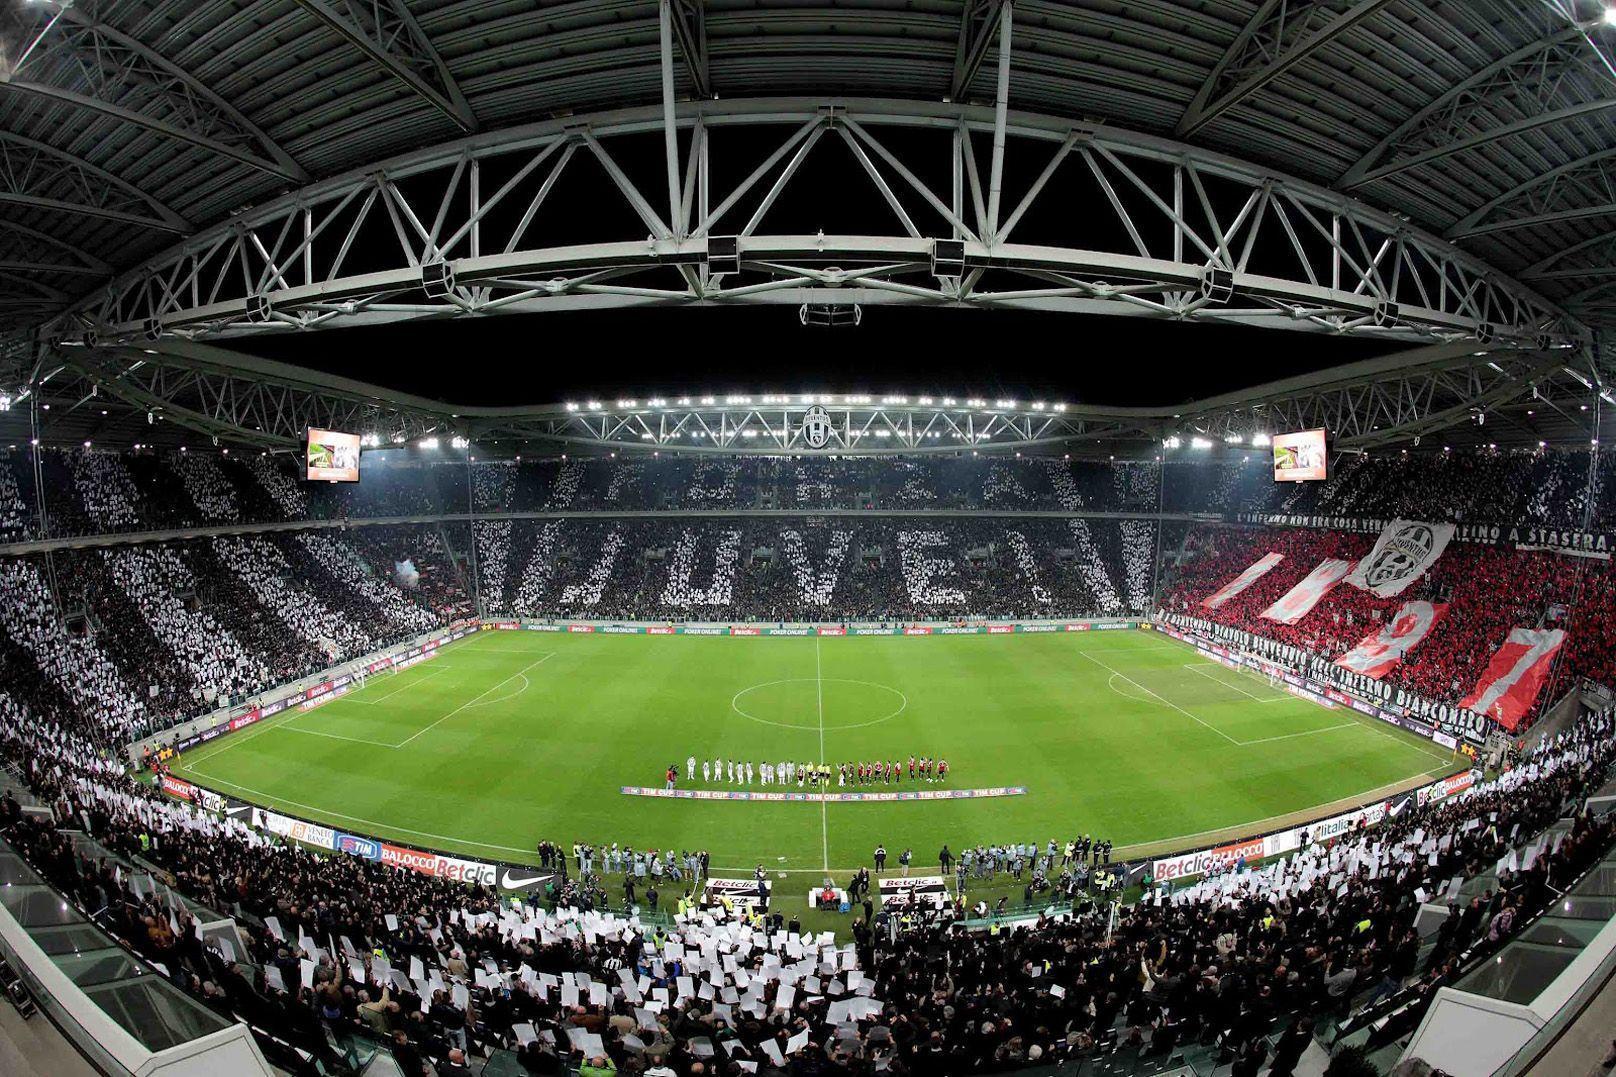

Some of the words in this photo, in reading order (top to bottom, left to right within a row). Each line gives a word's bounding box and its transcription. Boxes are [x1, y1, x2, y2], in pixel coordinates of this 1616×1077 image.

[1312, 516, 1330, 527] ERA
[1333, 517, 1357, 529] COSA
[1509, 528, 1519, 541] A
[1215, 623, 1250, 646] DIAVOLO
[1254, 636, 1307, 665] BENVENUTO
[1397, 689, 1485, 733] BIANCONERO
[1320, 818, 1349, 838] litalia
[354, 841, 373, 856] TIM
[381, 848, 435, 870] BALOCCO
[436, 858, 495, 885] Betclic
[1155, 853, 1211, 880] Betclic
